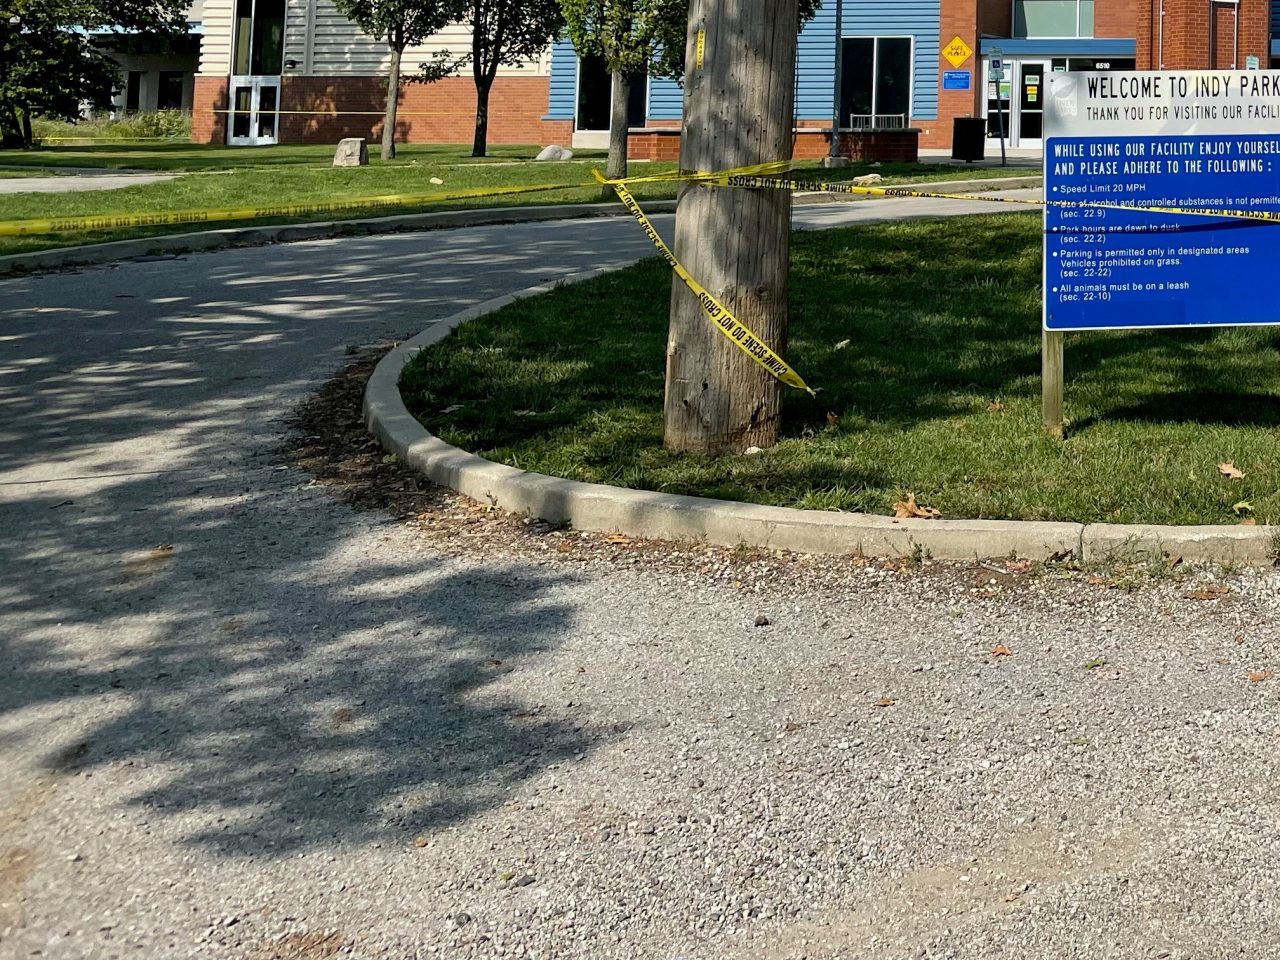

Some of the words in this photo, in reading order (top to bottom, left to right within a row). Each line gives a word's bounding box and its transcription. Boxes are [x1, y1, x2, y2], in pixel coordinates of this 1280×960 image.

[1087, 76, 1162, 99] WELCOME
[1168, 76, 1187, 98] TO
[1196, 75, 1231, 98] INDY
[1086, 106, 1120, 121] THANK
[1124, 106, 1144, 120] YOU
[1149, 106, 1169, 120] FOR
[1174, 106, 1217, 119] VISITING
[1222, 105, 1242, 119] OUR
[1054, 144, 1085, 157] WHILE
[1090, 144, 1120, 157] USING
[1125, 143, 1145, 156] OUR
[1151, 143, 1194, 156] FACILITY
[1200, 142, 1231, 155] ENJOY
[1054, 162, 1074, 175] AND
[1080, 162, 1118, 175] PLEASE
[1124, 161, 1162, 174] ADHERE
[1167, 161, 1179, 173] TO
[1185, 160, 1202, 173] THE
[1208, 160, 1263, 173] FOLLOWING
[727, 176, 757, 188] CROSS
[759, 177, 776, 189] NOT
[1060, 185, 1087, 194] Speed
[1090, 184, 1110, 192] Limit
[1113, 184, 1124, 192] 20
[1126, 184, 1146, 192] MPH
[1120, 199, 1135, 207] and
[1137, 198, 1177, 207] controlled
[1179, 197, 1224, 206] substances
[1226, 197, 1233, 205] is
[1235, 197, 1248, 205] not
[1240, 210, 1265, 219] SCENE
[1124, 224, 1147, 232] dawn
[1160, 223, 1180, 232] dusk
[1060, 250, 1092, 259] Parking
[1095, 249, 1103, 257] is
[1105, 248, 1145, 259] permitted
[1147, 248, 1165, 257] only
[1167, 247, 1175, 256] in
[1178, 247, 1224, 257] designated
[1226, 247, 1250, 255] areas
[1060, 259, 1097, 268] Vehicles
[1099, 258, 1141, 268] prohibited
[1084, 268, 1112, 278] 22-22)
[1060, 284, 1072, 293] All
[1074, 283, 1107, 292] animals
[1109, 283, 1130, 291] must
[1132, 282, 1143, 291] be
[1166, 281, 1190, 290] leash
[1083, 291, 1112, 302] 22-10)
[698, 292, 721, 317] CROSS
[717, 314, 736, 331] NOT
[732, 327, 747, 341] DO
[742, 335, 767, 359] SCENE
[763, 354, 787, 376] CRIME
